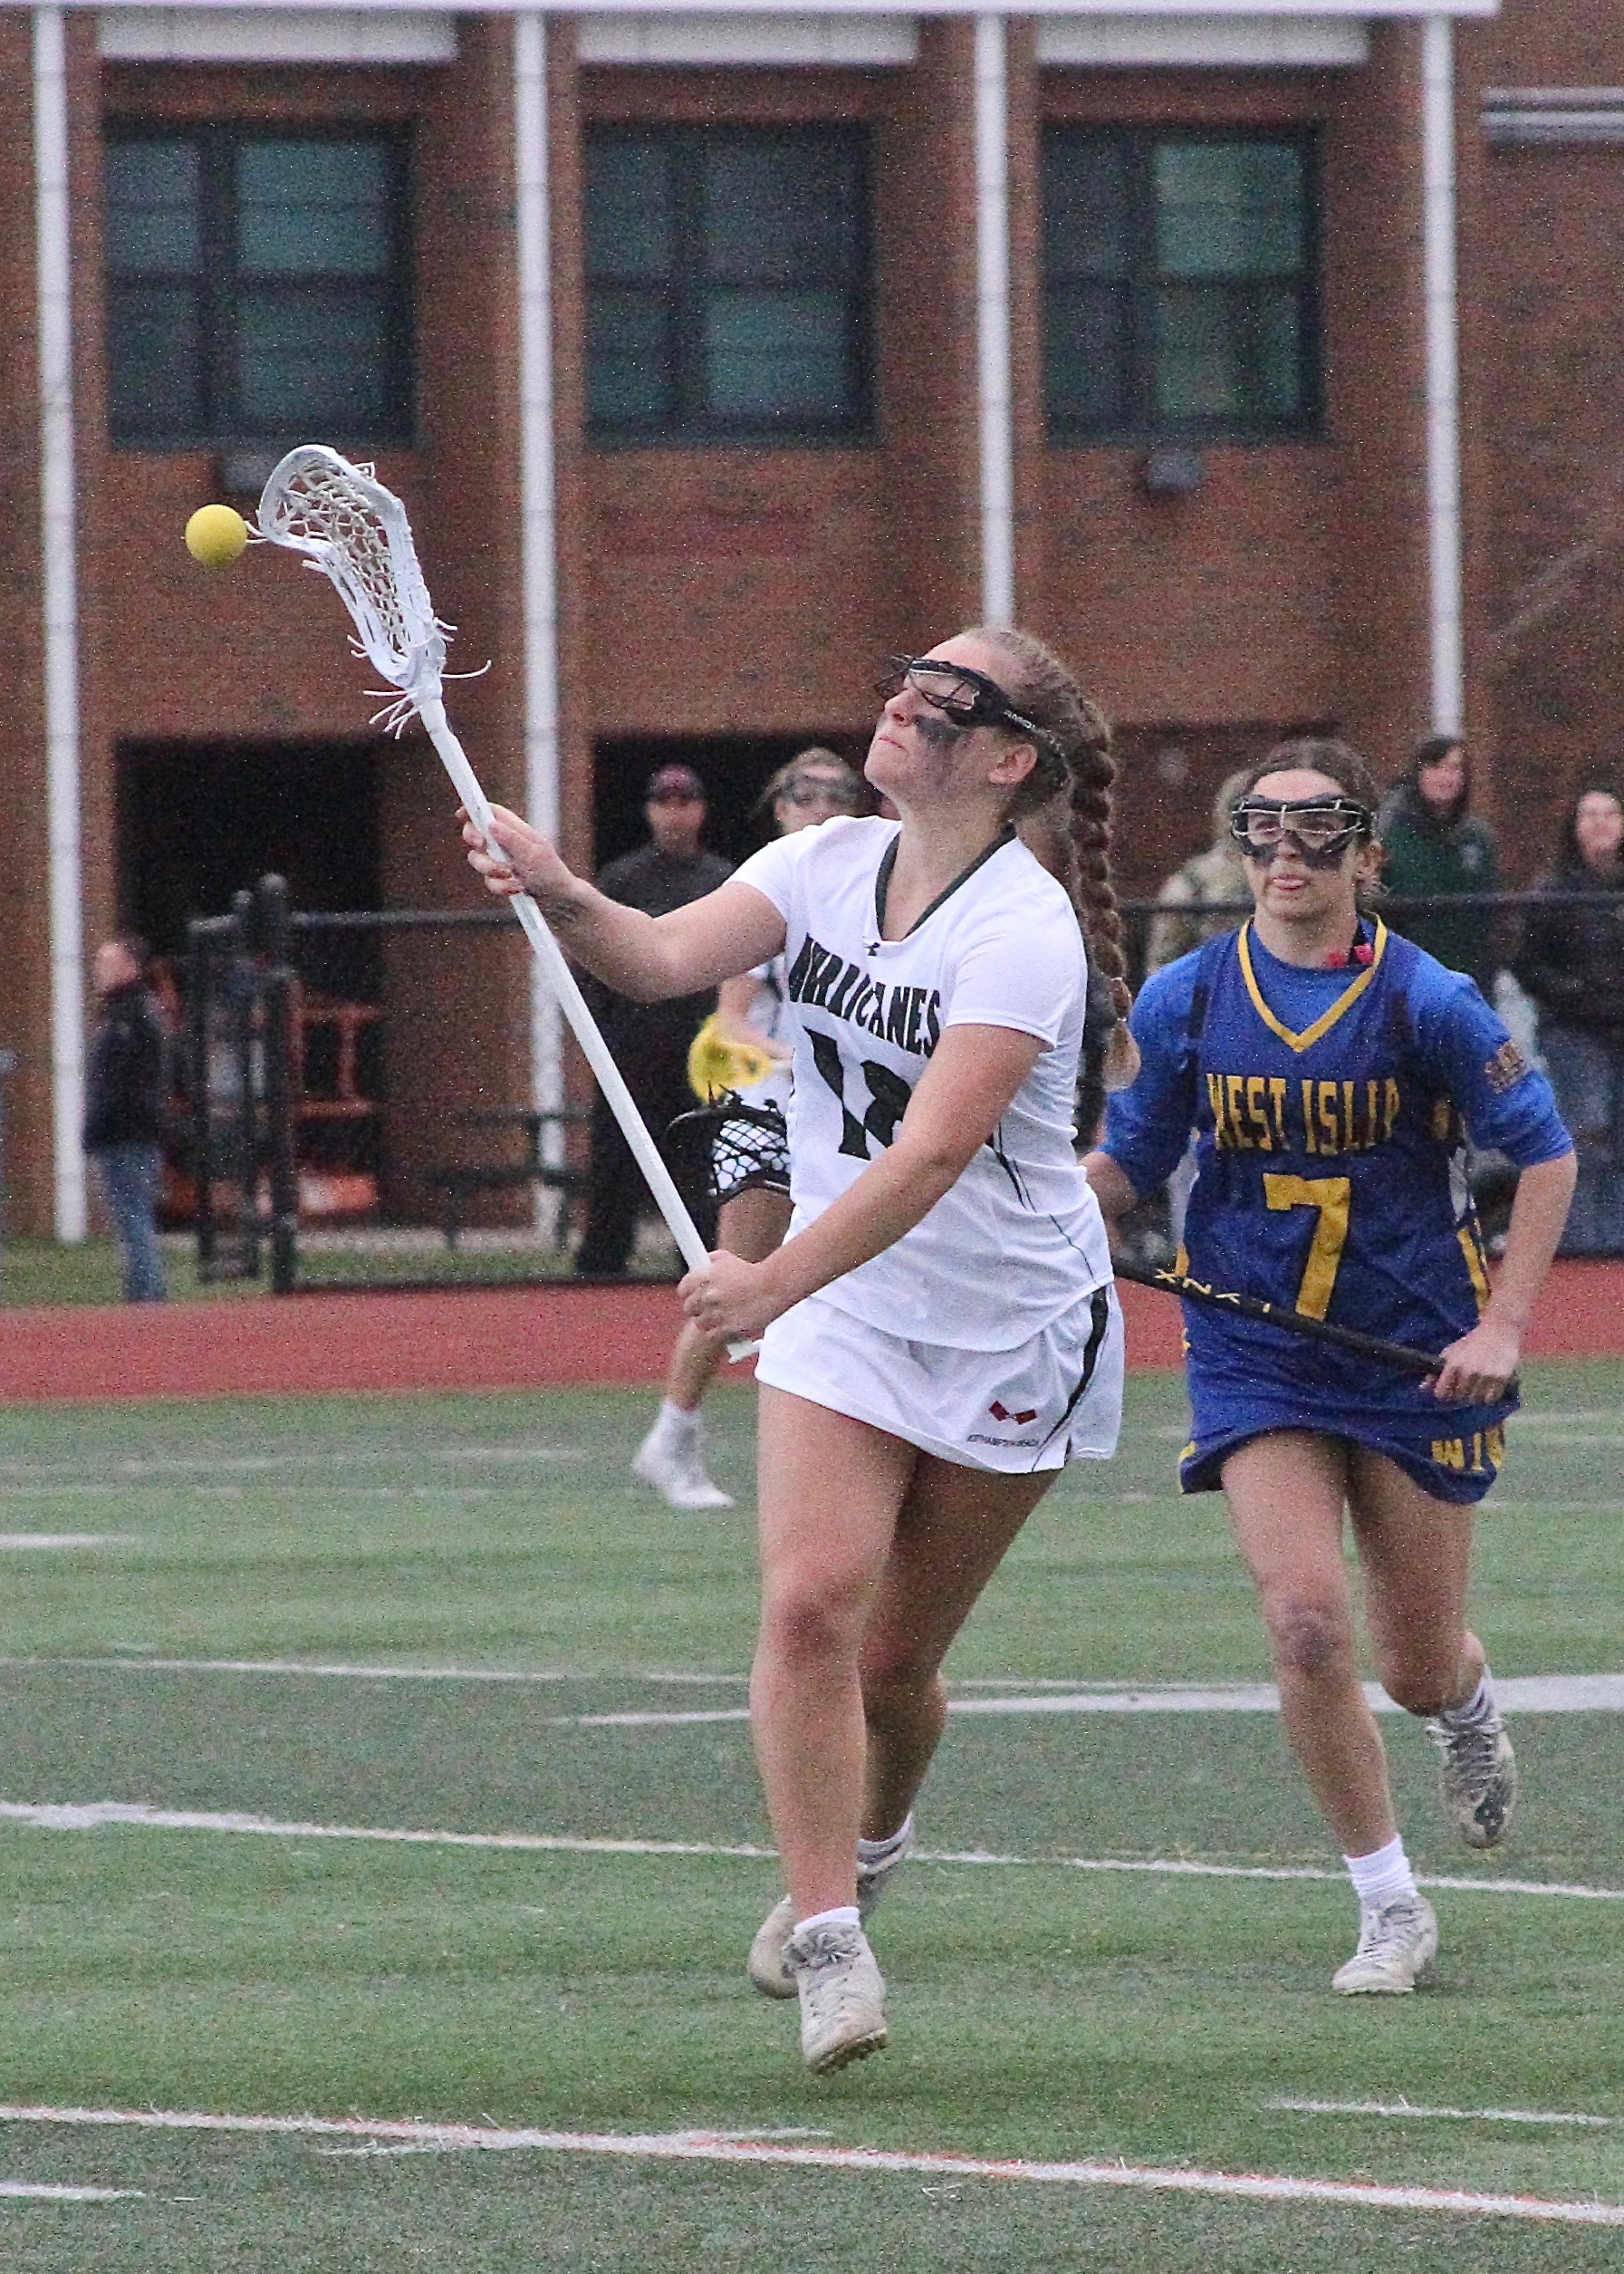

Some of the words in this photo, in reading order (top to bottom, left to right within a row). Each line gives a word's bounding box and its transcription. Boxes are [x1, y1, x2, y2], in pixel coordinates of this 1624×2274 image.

[1206, 1073, 1290, 1151] WEST
[1302, 1077, 1399, 1154] ISLIP
[1263, 1173, 1350, 1320] 7
